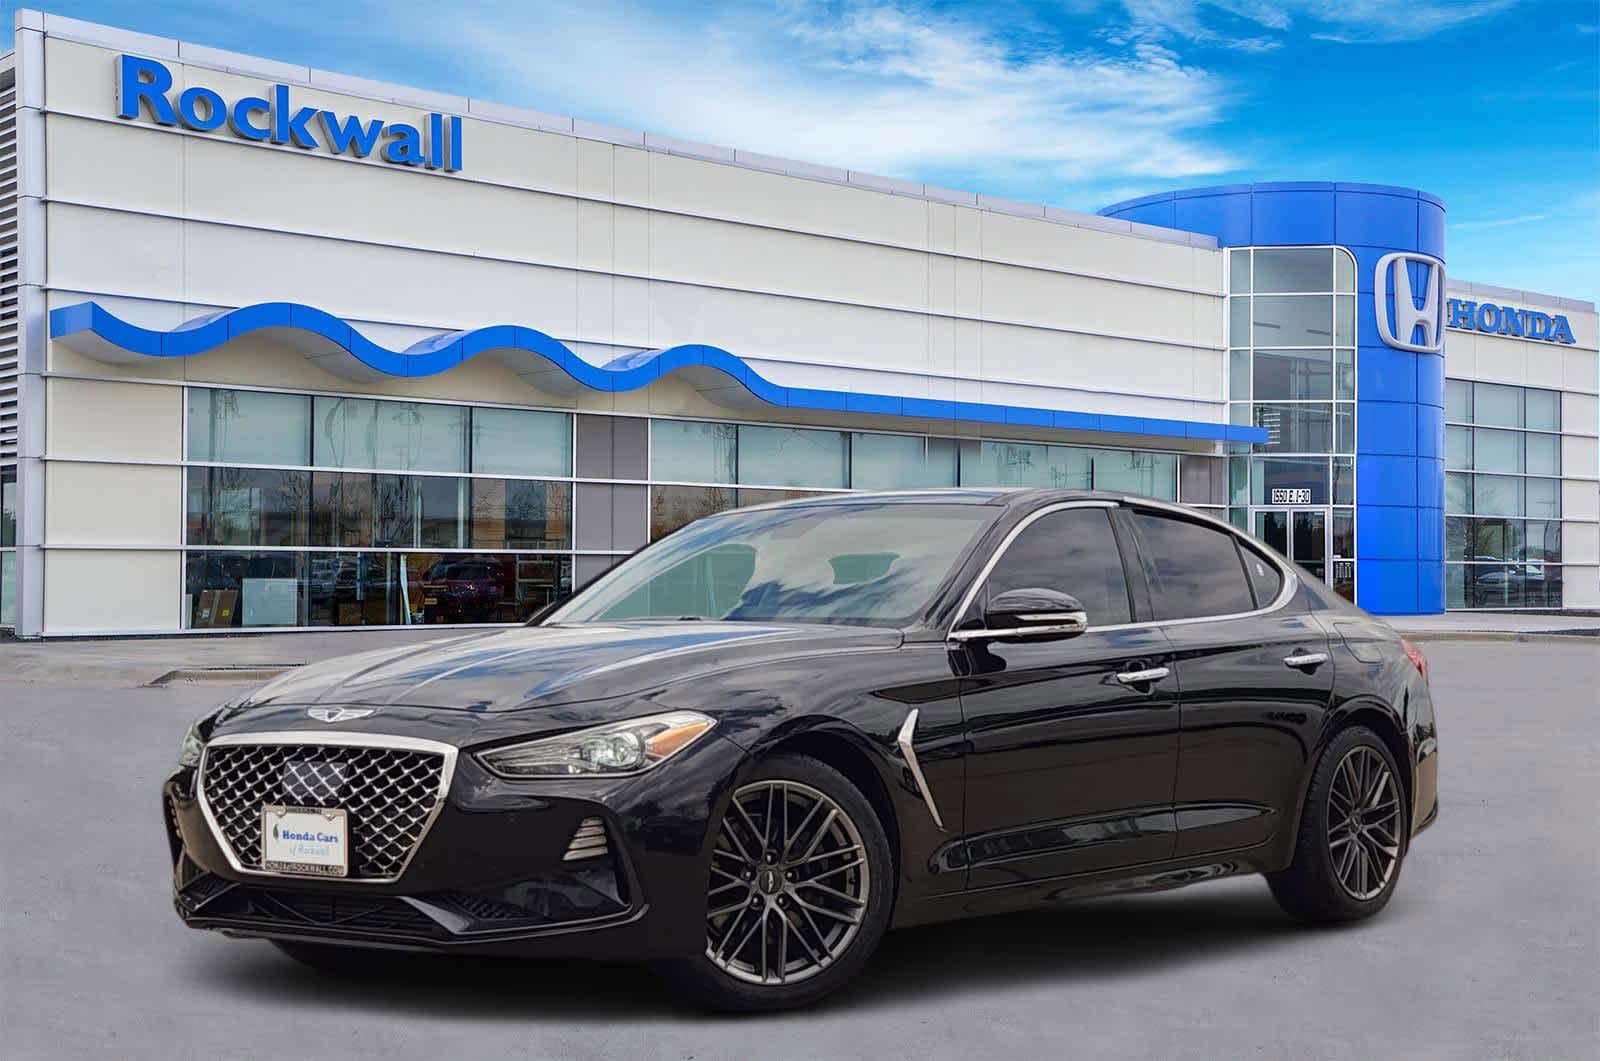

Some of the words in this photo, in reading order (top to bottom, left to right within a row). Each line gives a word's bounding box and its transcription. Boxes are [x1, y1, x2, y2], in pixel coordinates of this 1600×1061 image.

[117, 53, 463, 172] Rockwall
[1446, 298, 1576, 345] HONDA
[282, 830, 315, 841] Honda
[316, 832, 339, 843] Cars
